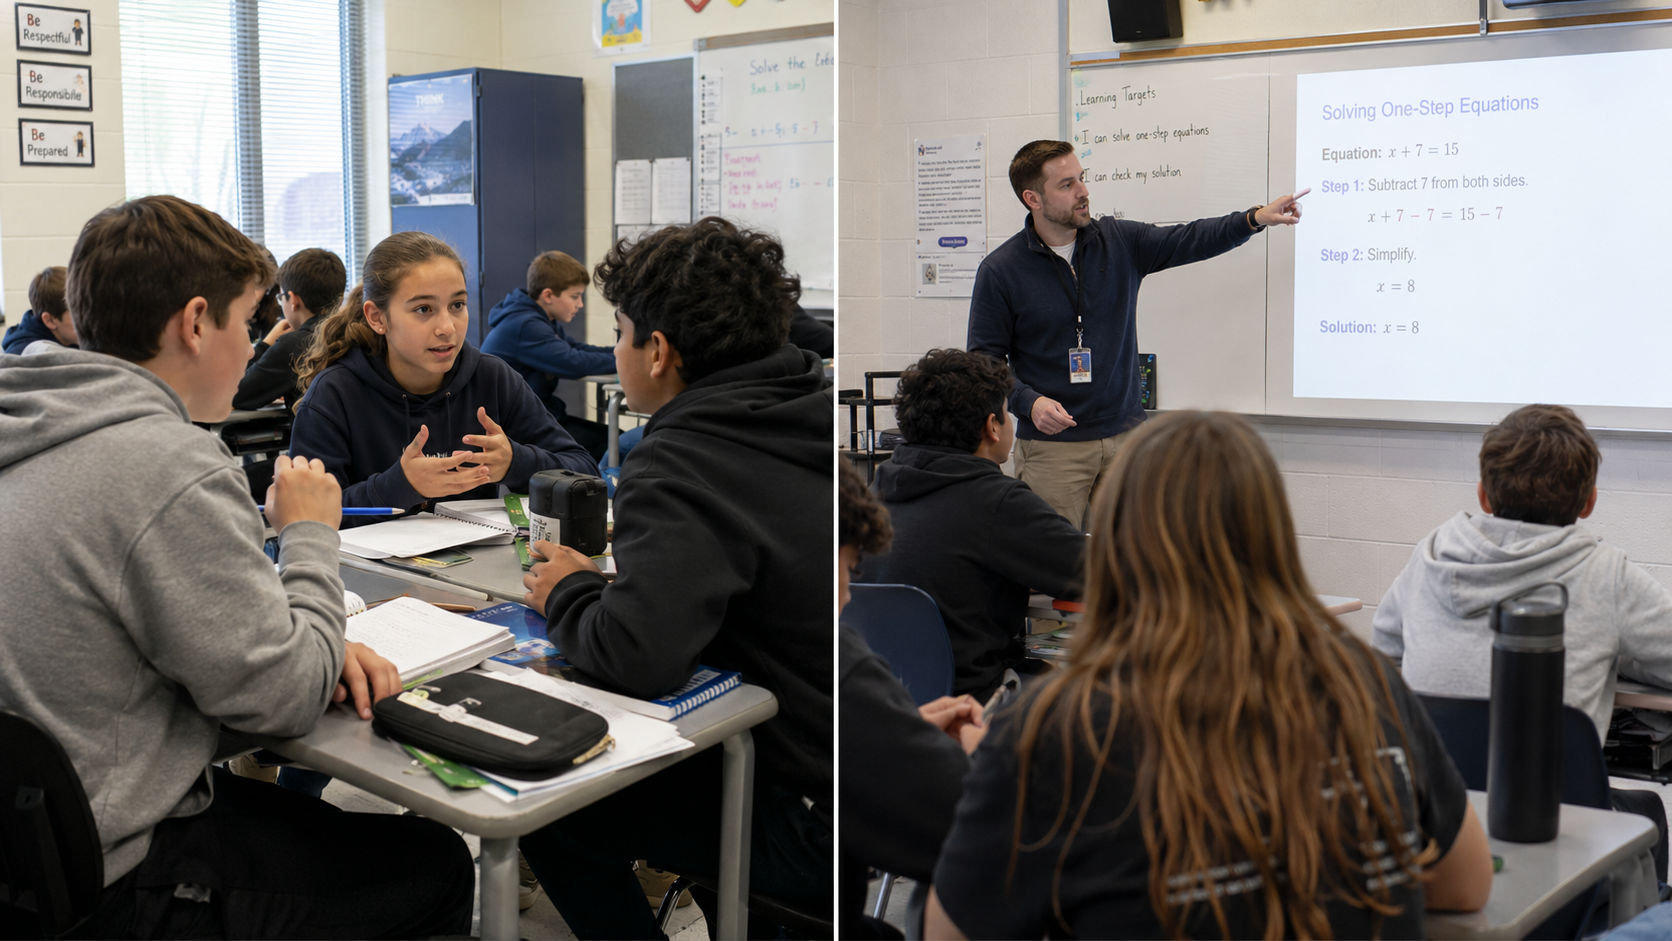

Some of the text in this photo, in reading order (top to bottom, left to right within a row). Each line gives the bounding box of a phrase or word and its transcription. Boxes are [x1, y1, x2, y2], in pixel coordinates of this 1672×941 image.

[27, 14, 40, 26] Be
[750, 59, 779, 75] Solve
[788, 56, 805, 70] the
[30, 70, 43, 83] Be
[1080, 85, 1156, 109] Learning Targets
[1322, 95, 1539, 122] Solving One-Step Equations
[32, 128, 44, 141] Be
[1082, 123, 1210, 145] I can solve one-step equations
[27, 144, 68, 158] Prepared
[1322, 147, 1382, 163] Equation:
[1388, 148, 1397, 158] x
[1415, 144, 1423, 157] 7
[1444, 142, 1459, 156] 15
[1095, 173, 1107, 182] can
[1112, 168, 1131, 181] check
[1136, 172, 1147, 184] my
[1152, 164, 1182, 179] solution
[1322, 174, 1528, 195] Step 1: Subtract 7 from both sides.
[1368, 213, 1375, 223] x
[1396, 209, 1404, 221] 7
[1427, 208, 1434, 221] 7
[1460, 207, 1475, 220] 15
[1496, 207, 1503, 219] 7
[1320, 248, 1417, 264] Step 2: Simplify.
[1376, 283, 1385, 292] x
[1407, 279, 1415, 292] 8
[1320, 321, 1376, 334] Solution:
[1383, 324, 1391, 334] x
[1411, 321, 1419, 334] 8
